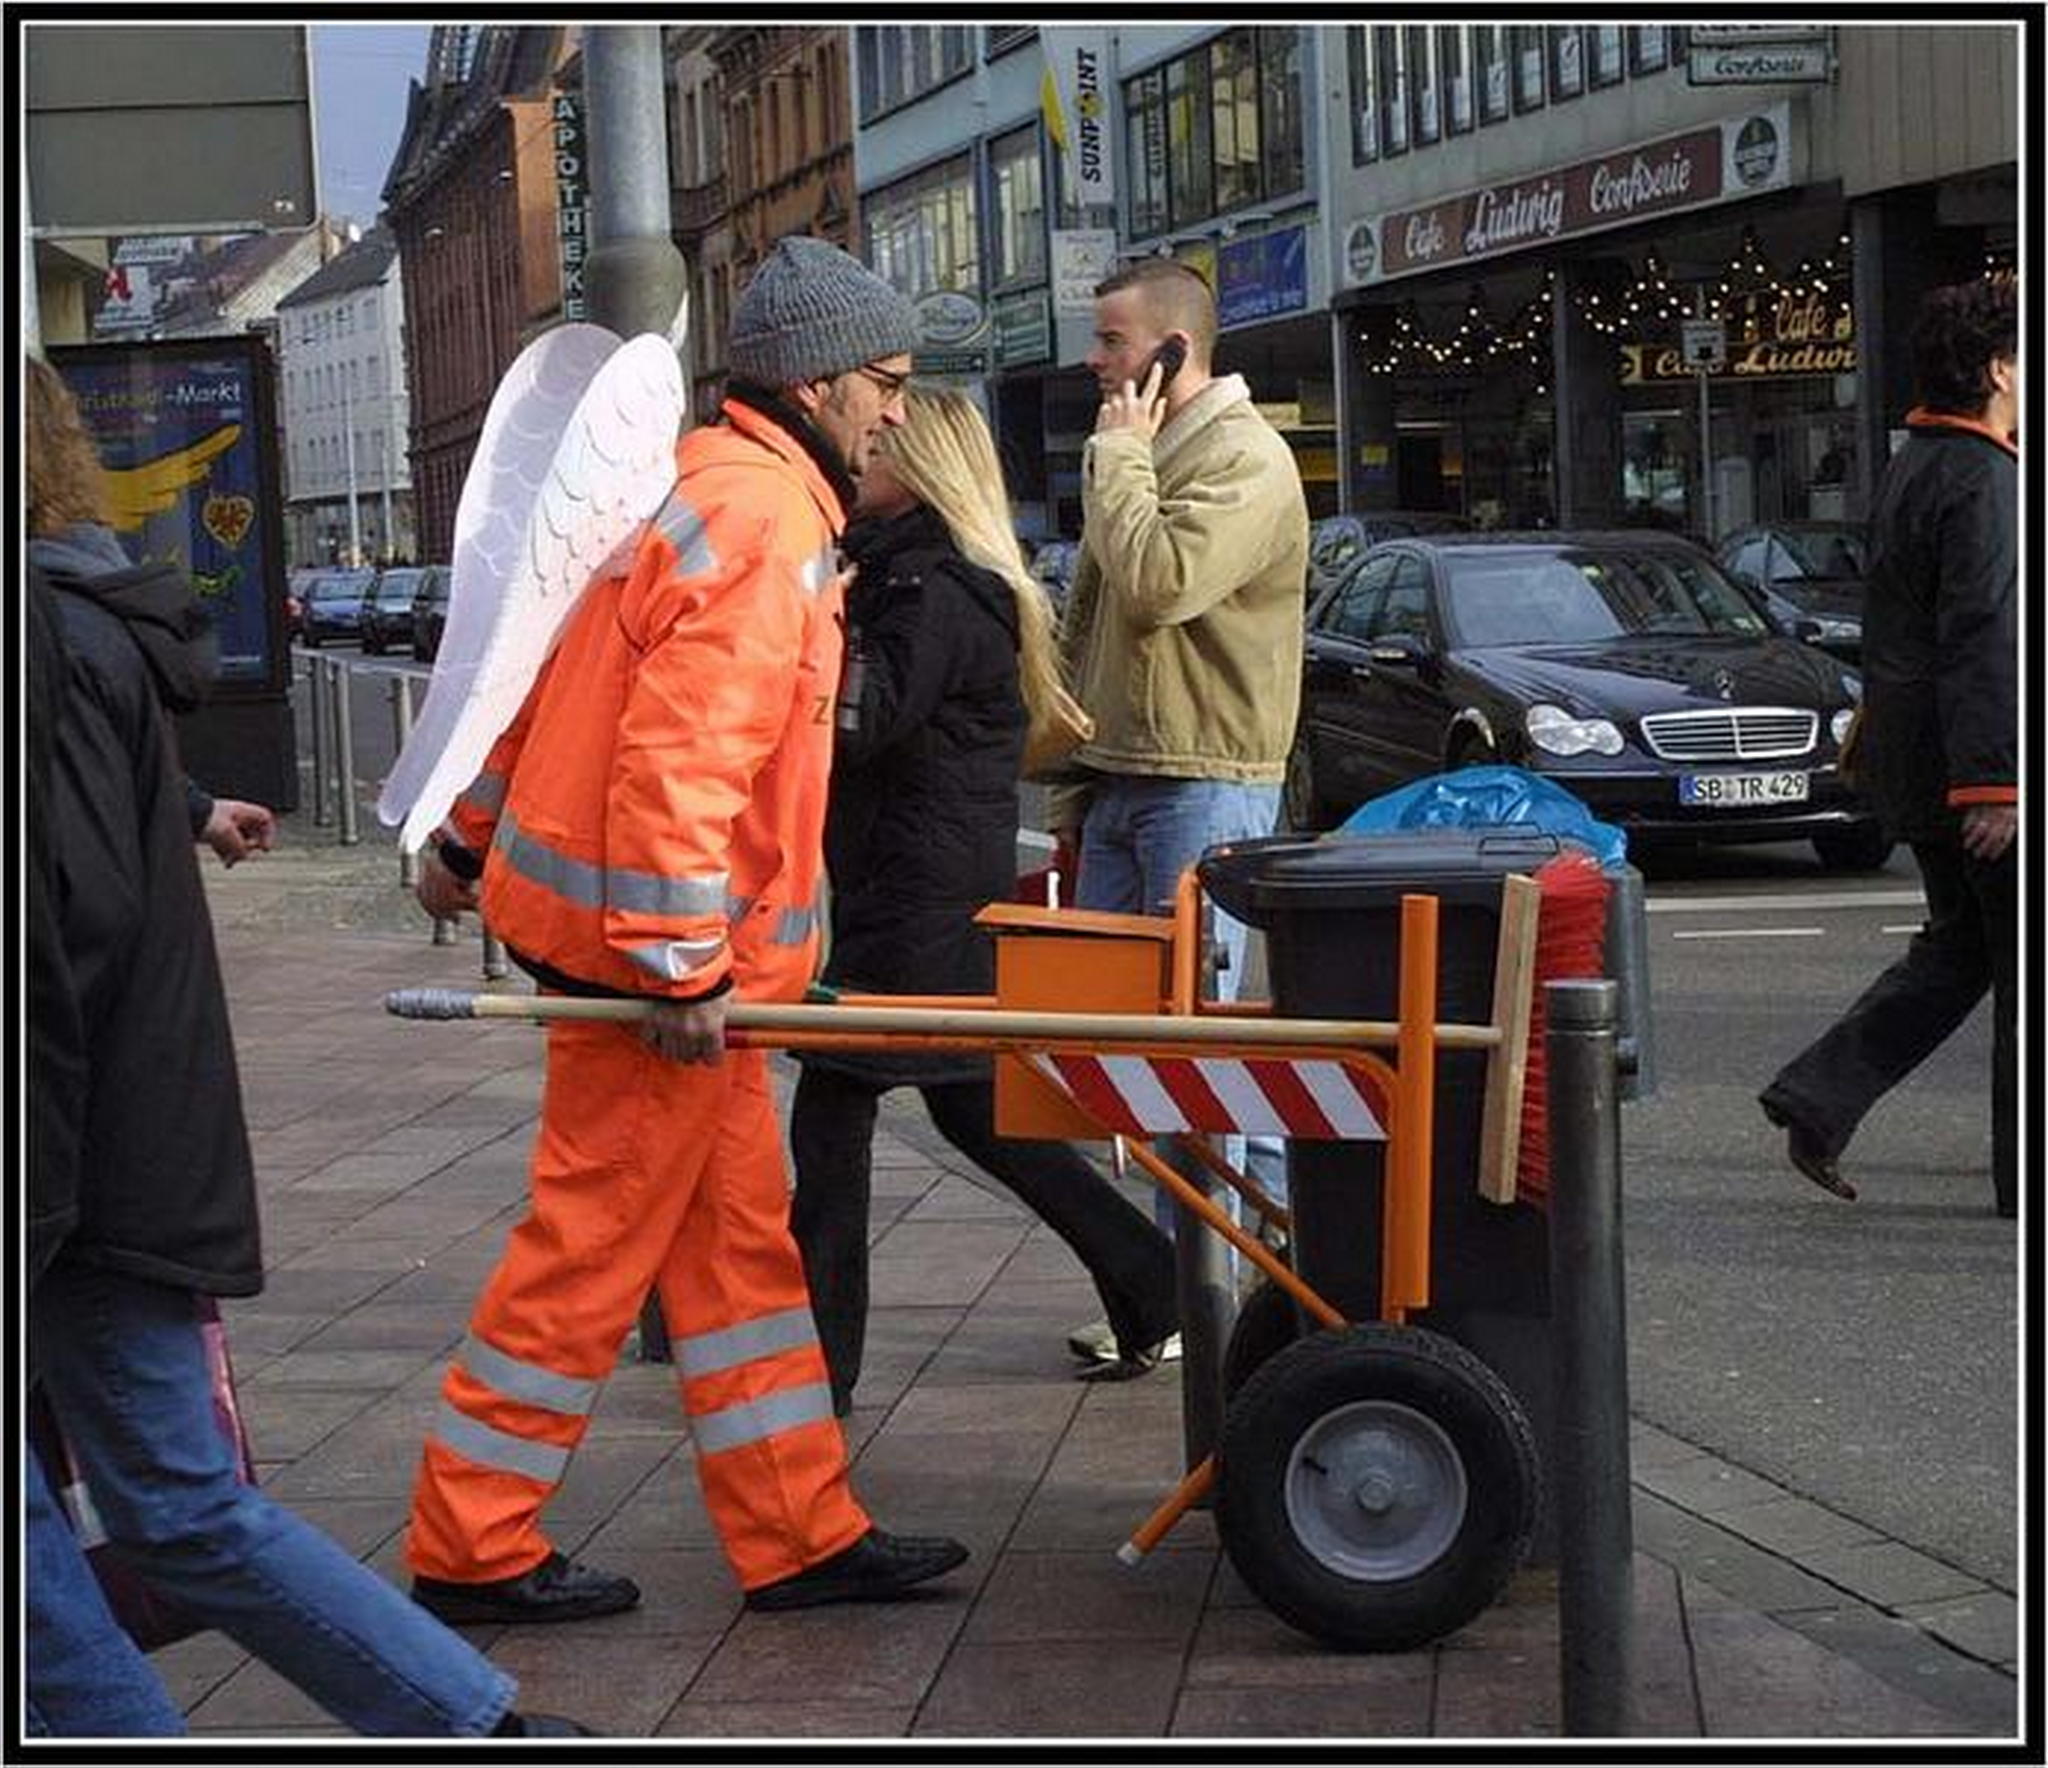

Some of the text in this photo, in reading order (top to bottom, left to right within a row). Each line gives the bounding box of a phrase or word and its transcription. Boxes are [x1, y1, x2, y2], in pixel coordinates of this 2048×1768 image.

[555, 99, 585, 320] APOTHEKE
[1464, 180, 1563, 253] Ludwig
[1693, 774, 1804, 800] SB TR 429
